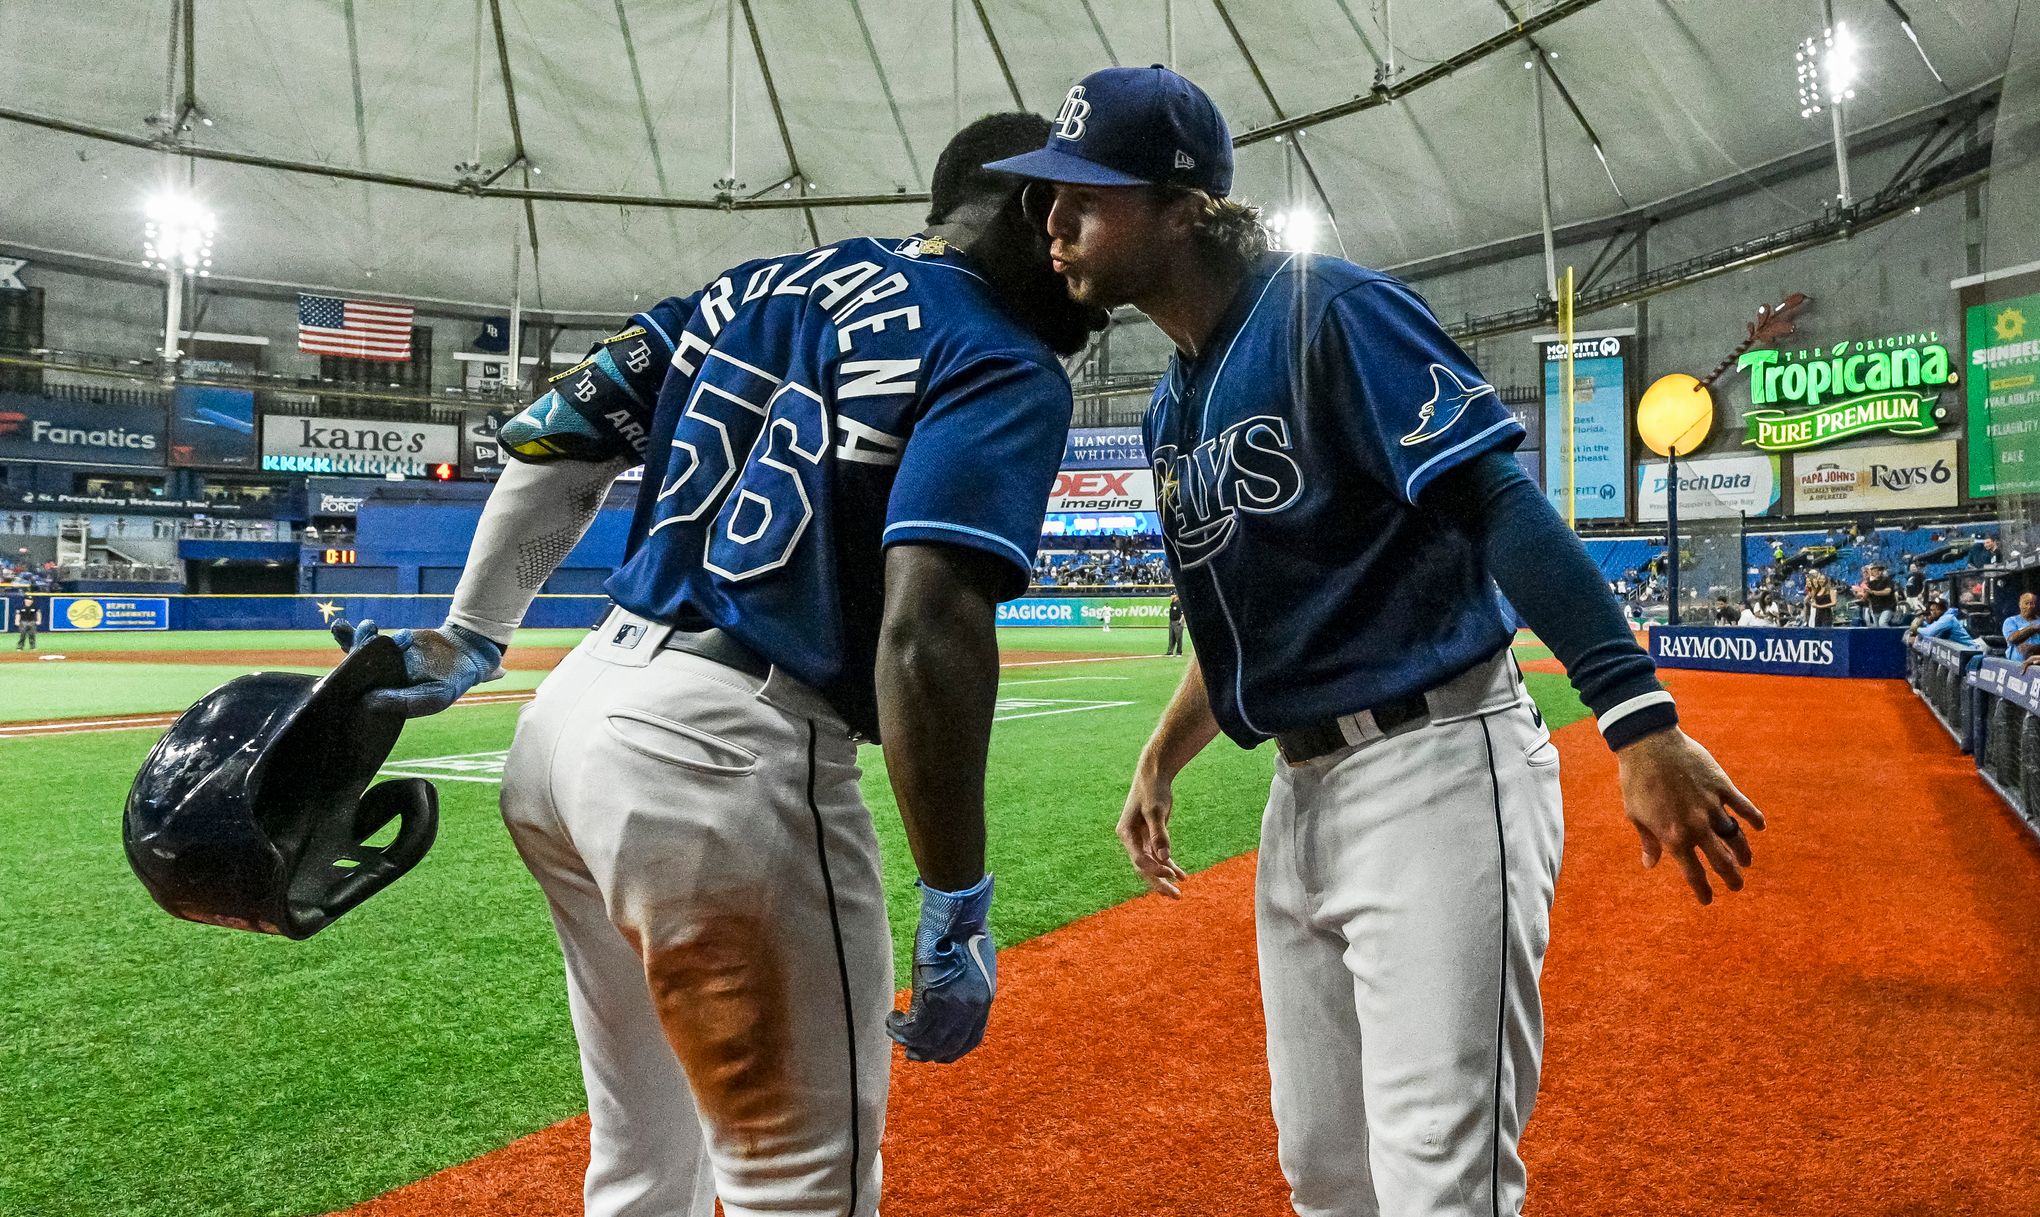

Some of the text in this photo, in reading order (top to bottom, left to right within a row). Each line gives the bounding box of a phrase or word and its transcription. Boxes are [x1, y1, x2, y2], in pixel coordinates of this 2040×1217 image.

[626, 339, 652, 374] TB
[1784, 331, 1938, 361] THE ORIGINAL
[1737, 345, 1949, 405] Tropicana
[32, 421, 156, 449] Fanatics
[1758, 397, 1920, 445] PURE PREMIUM
[649, 349, 830, 582] 56
[1074, 449, 1147, 461] WHITNEY
[436, 463, 451, 480] 4
[1711, 473, 1751, 490] Data
[1801, 471, 1823, 484] PAPA
[1870, 459, 1951, 492] RAYS 6
[1060, 497, 1143, 510] imaging
[1554, 486, 1598, 496] MOFITT
[997, 604, 1073, 620] SAGICOR
[1658, 635, 1834, 665] RAYMOND JAMES
